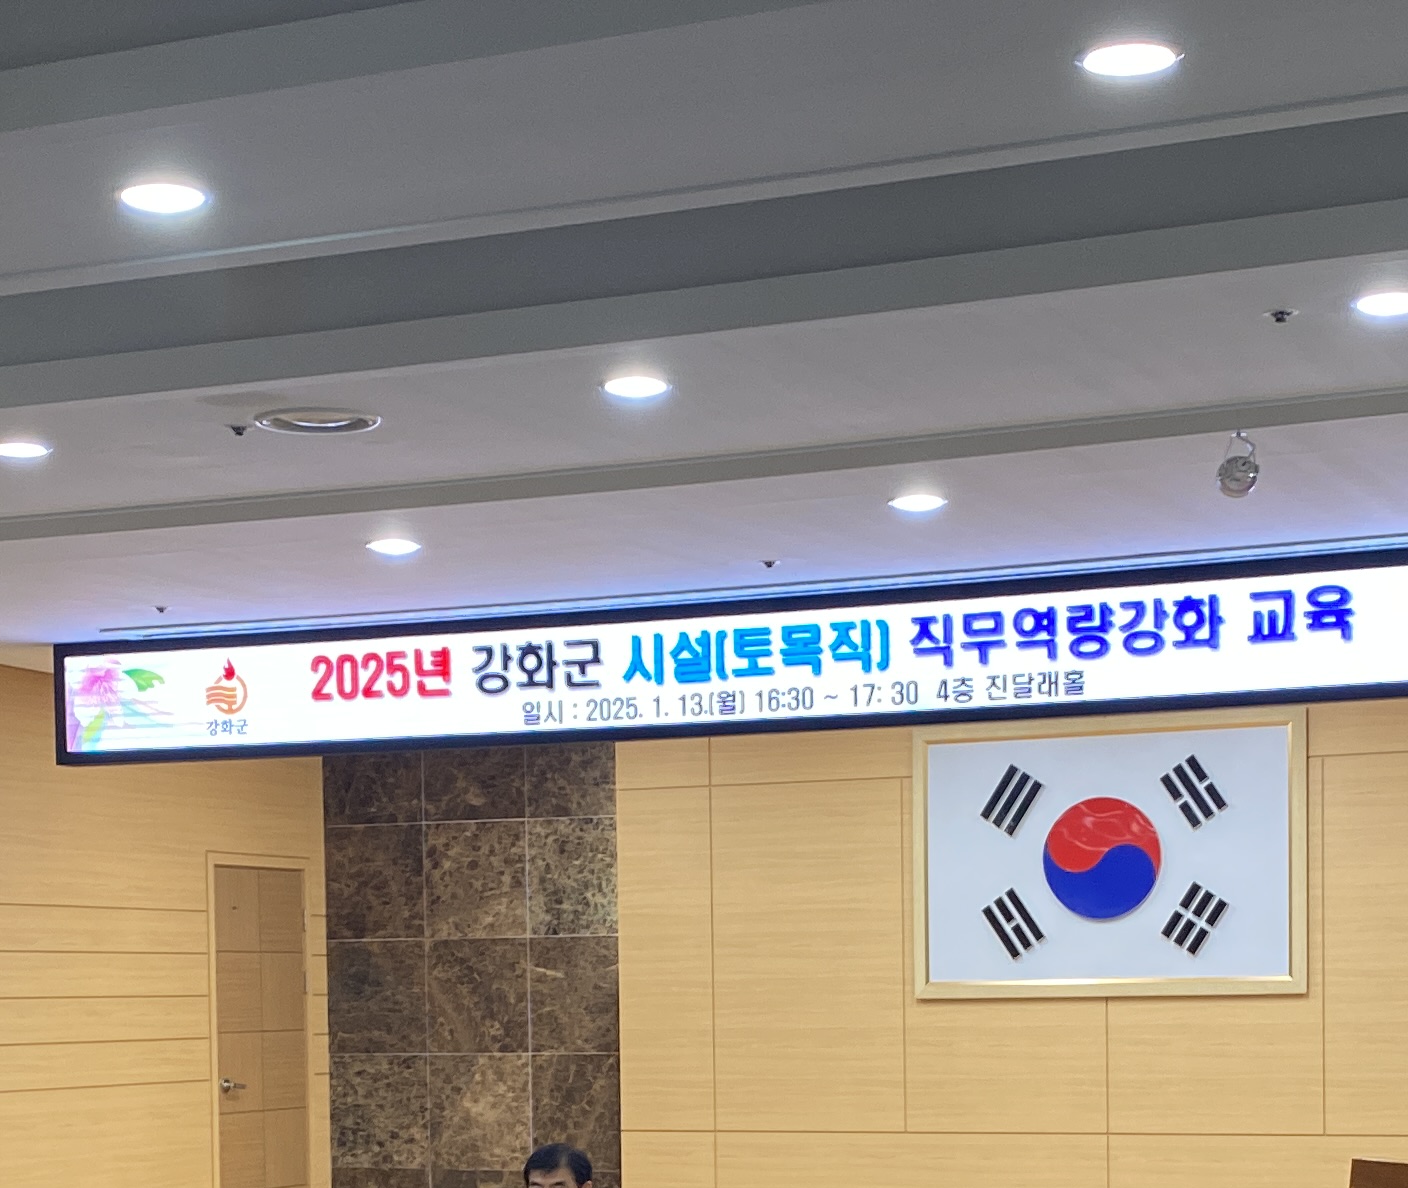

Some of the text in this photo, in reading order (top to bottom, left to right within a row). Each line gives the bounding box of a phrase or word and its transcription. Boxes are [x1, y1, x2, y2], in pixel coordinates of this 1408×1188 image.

[311, 584, 1355, 701] 2025년 강화군 시설(토목직) 직무역량강화 교육
[522, 700, 563, 725] 일시
[586, 696, 643, 721] 2025.
[652, 695, 669, 717] 1.
[679, 689, 745, 717] 13.(월)
[755, 686, 814, 713] 16:30
[936, 677, 973, 703] 4층
[986, 669, 1085, 700] 진달래홀
[206, 719, 248, 736] 강화군
